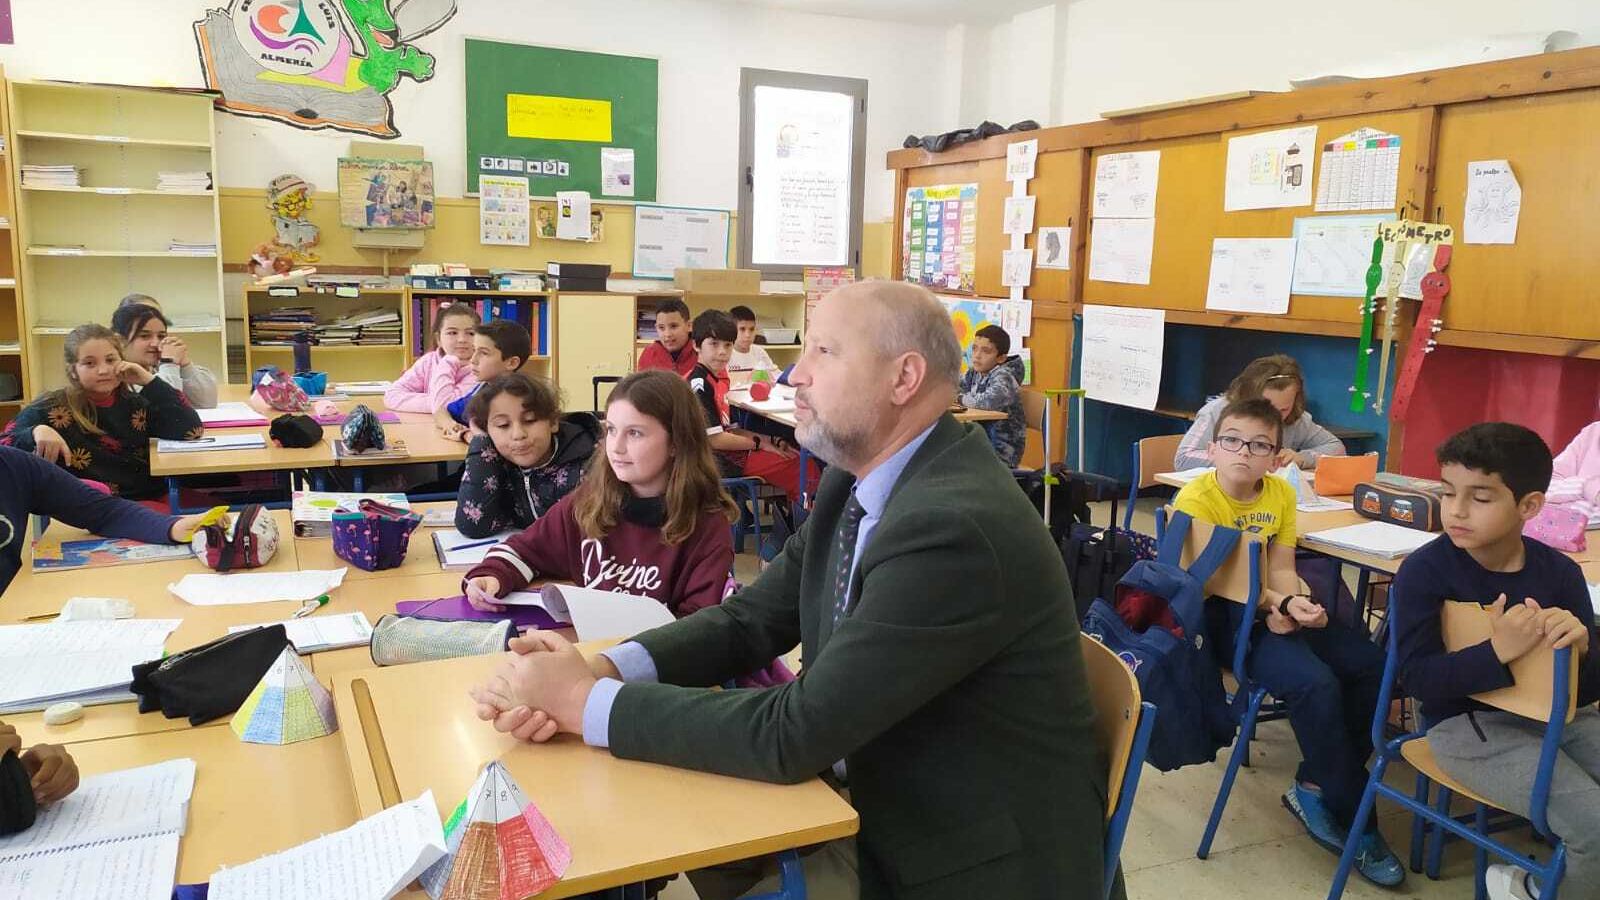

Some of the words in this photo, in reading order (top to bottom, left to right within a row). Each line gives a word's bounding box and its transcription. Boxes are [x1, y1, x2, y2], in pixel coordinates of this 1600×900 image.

[260, 53, 314, 68] ALMERÍA
[1250, 512, 1277, 525] POINT
[581, 538, 661, 590] Divine
[500, 790, 508, 802] 8
